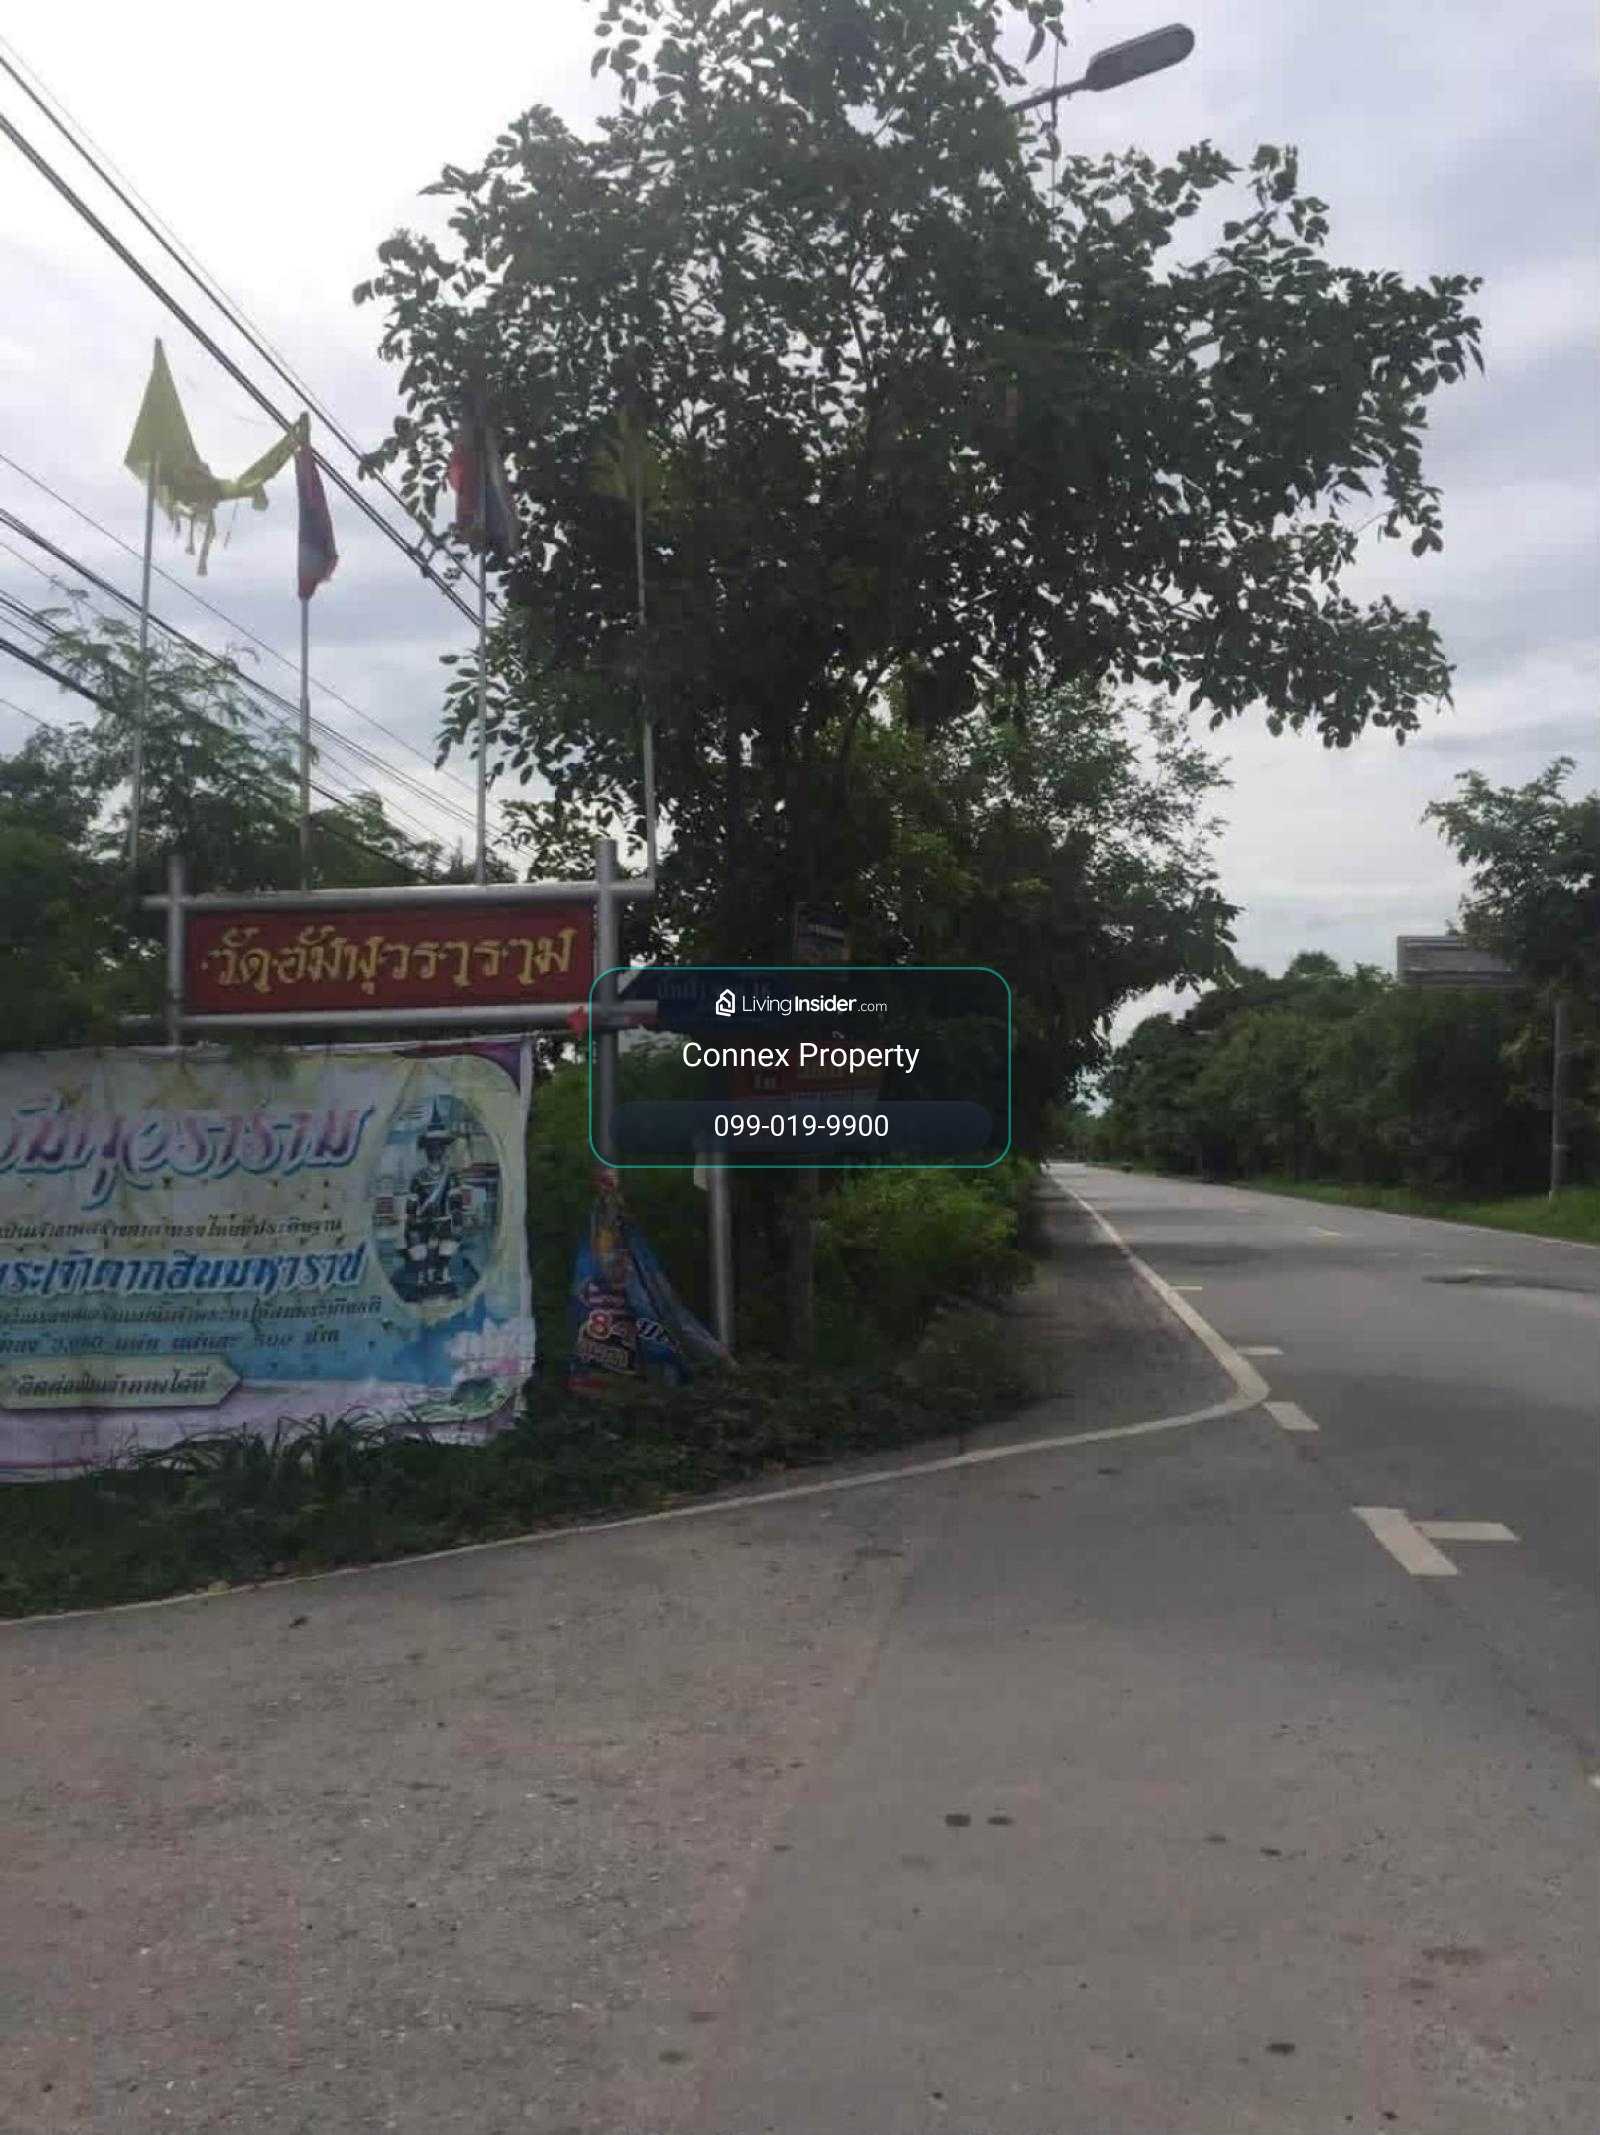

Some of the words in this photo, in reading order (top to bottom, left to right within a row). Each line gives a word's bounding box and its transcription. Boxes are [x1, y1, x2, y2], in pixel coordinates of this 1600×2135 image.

[204, 924, 578, 995] วัดอัมพุวราราม
